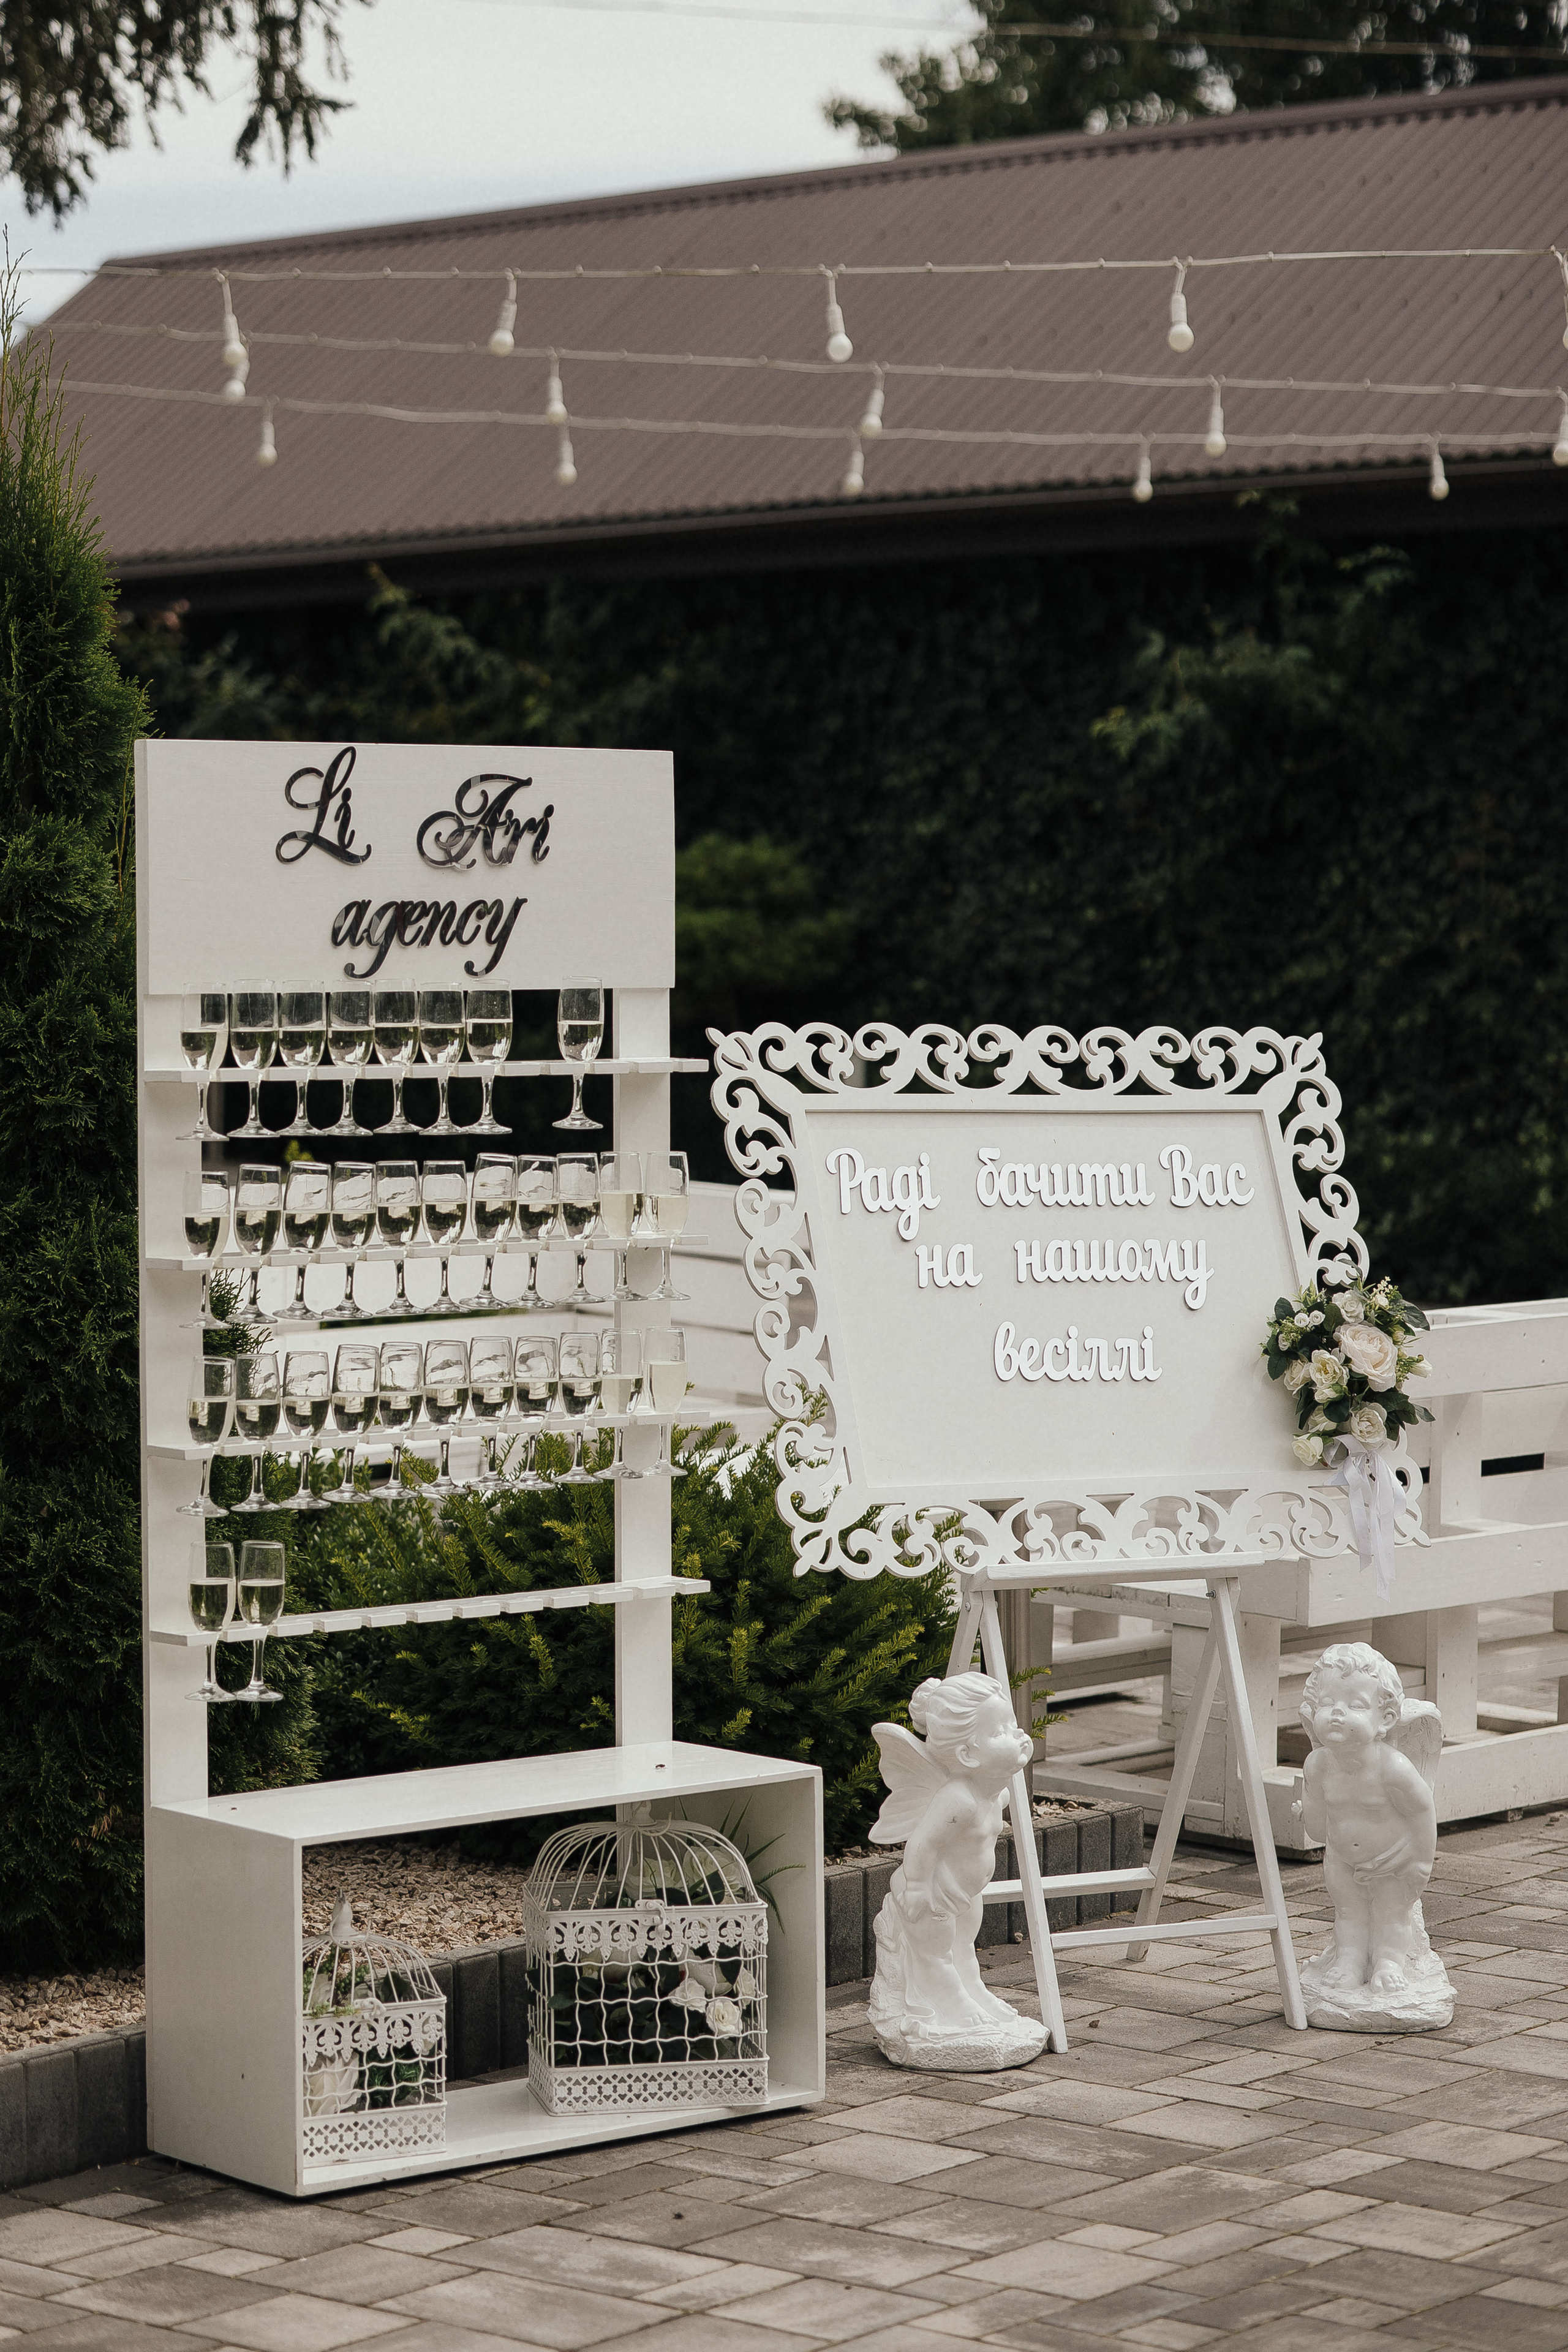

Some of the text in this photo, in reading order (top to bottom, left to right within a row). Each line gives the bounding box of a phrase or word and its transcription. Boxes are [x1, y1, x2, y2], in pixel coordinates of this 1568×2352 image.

[276, 746, 371, 865] Li
[331, 897, 528, 978] agency
[826, 1144, 1255, 1240] Раді бачити Вас
[916, 1239, 1215, 1310] на нашому
[993, 1321, 1163, 1381] весіллі
